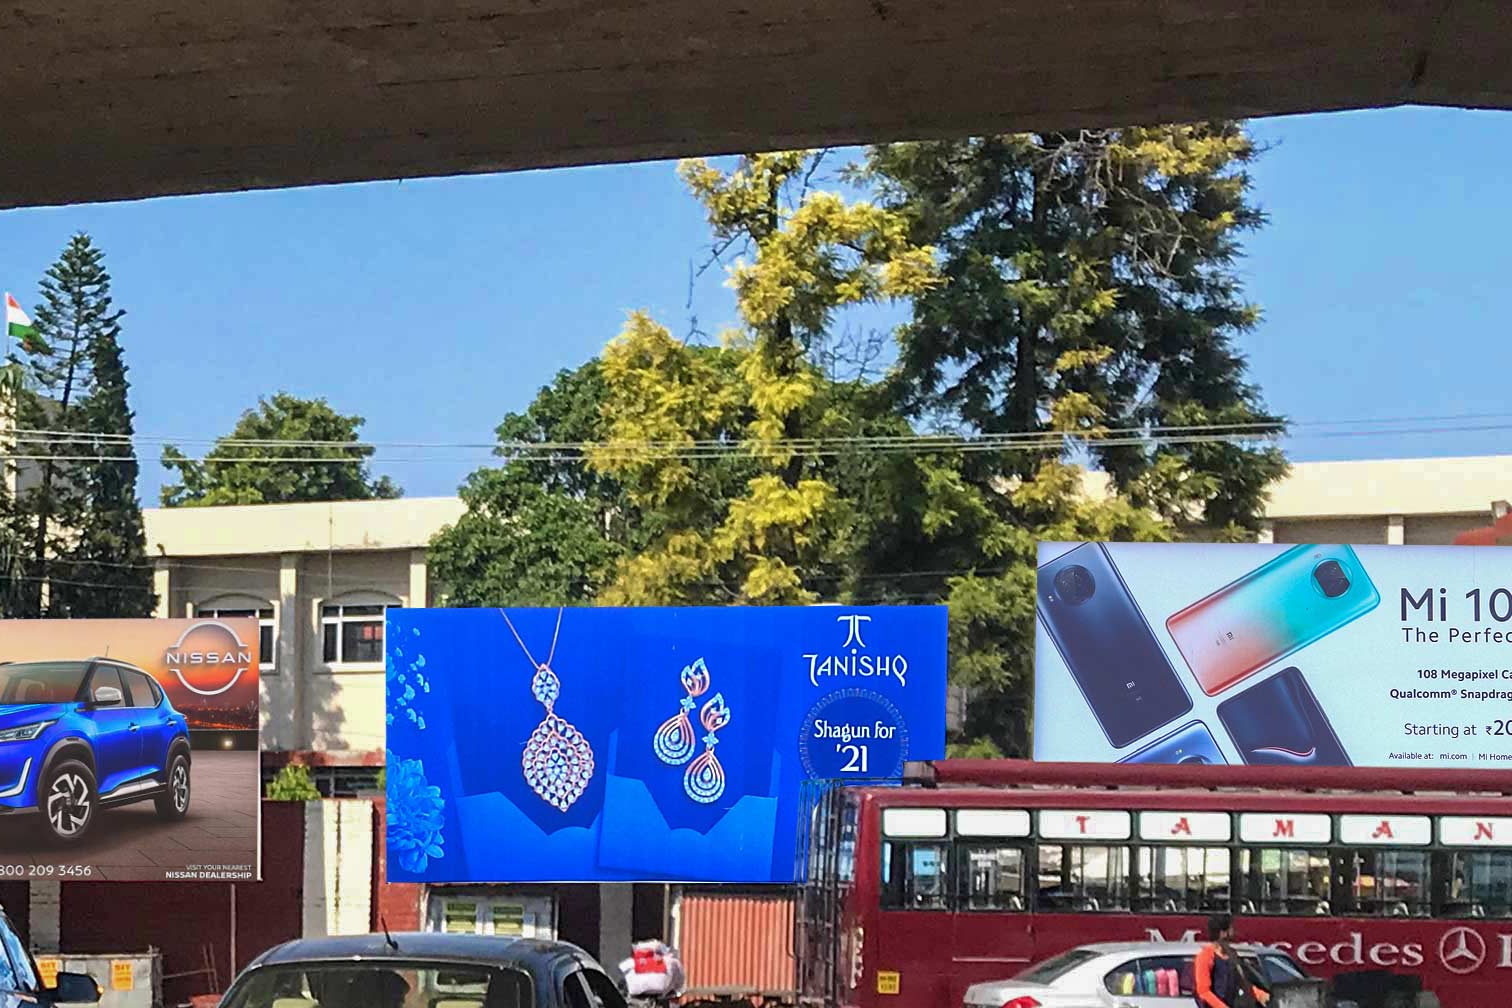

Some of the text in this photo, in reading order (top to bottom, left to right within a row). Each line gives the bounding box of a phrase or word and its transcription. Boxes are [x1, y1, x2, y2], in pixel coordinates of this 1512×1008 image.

[1400, 587, 1512, 623] Mi 10
[1401, 627, 1512, 643] The Perfec
[166, 651, 252, 664] NISSAN
[1417, 669, 1438, 680] 108
[1441, 669, 1498, 682] Megapixel
[1460, 688, 1512, 702] Snapdrag
[814, 719, 896, 742] Shagun for
[1404, 722, 1459, 739] Starting
[1463, 724, 1477, 736] at
[836, 743, 868, 772] '21
[1388, 752, 1512, 761] Available at: mi.com Mi Home
[29, 865, 54, 876] 209
[58, 865, 92, 876] 3456
[165, 871, 252, 879] NISSAN DEALERSHIP
[1144, 927, 1424, 966] edes
